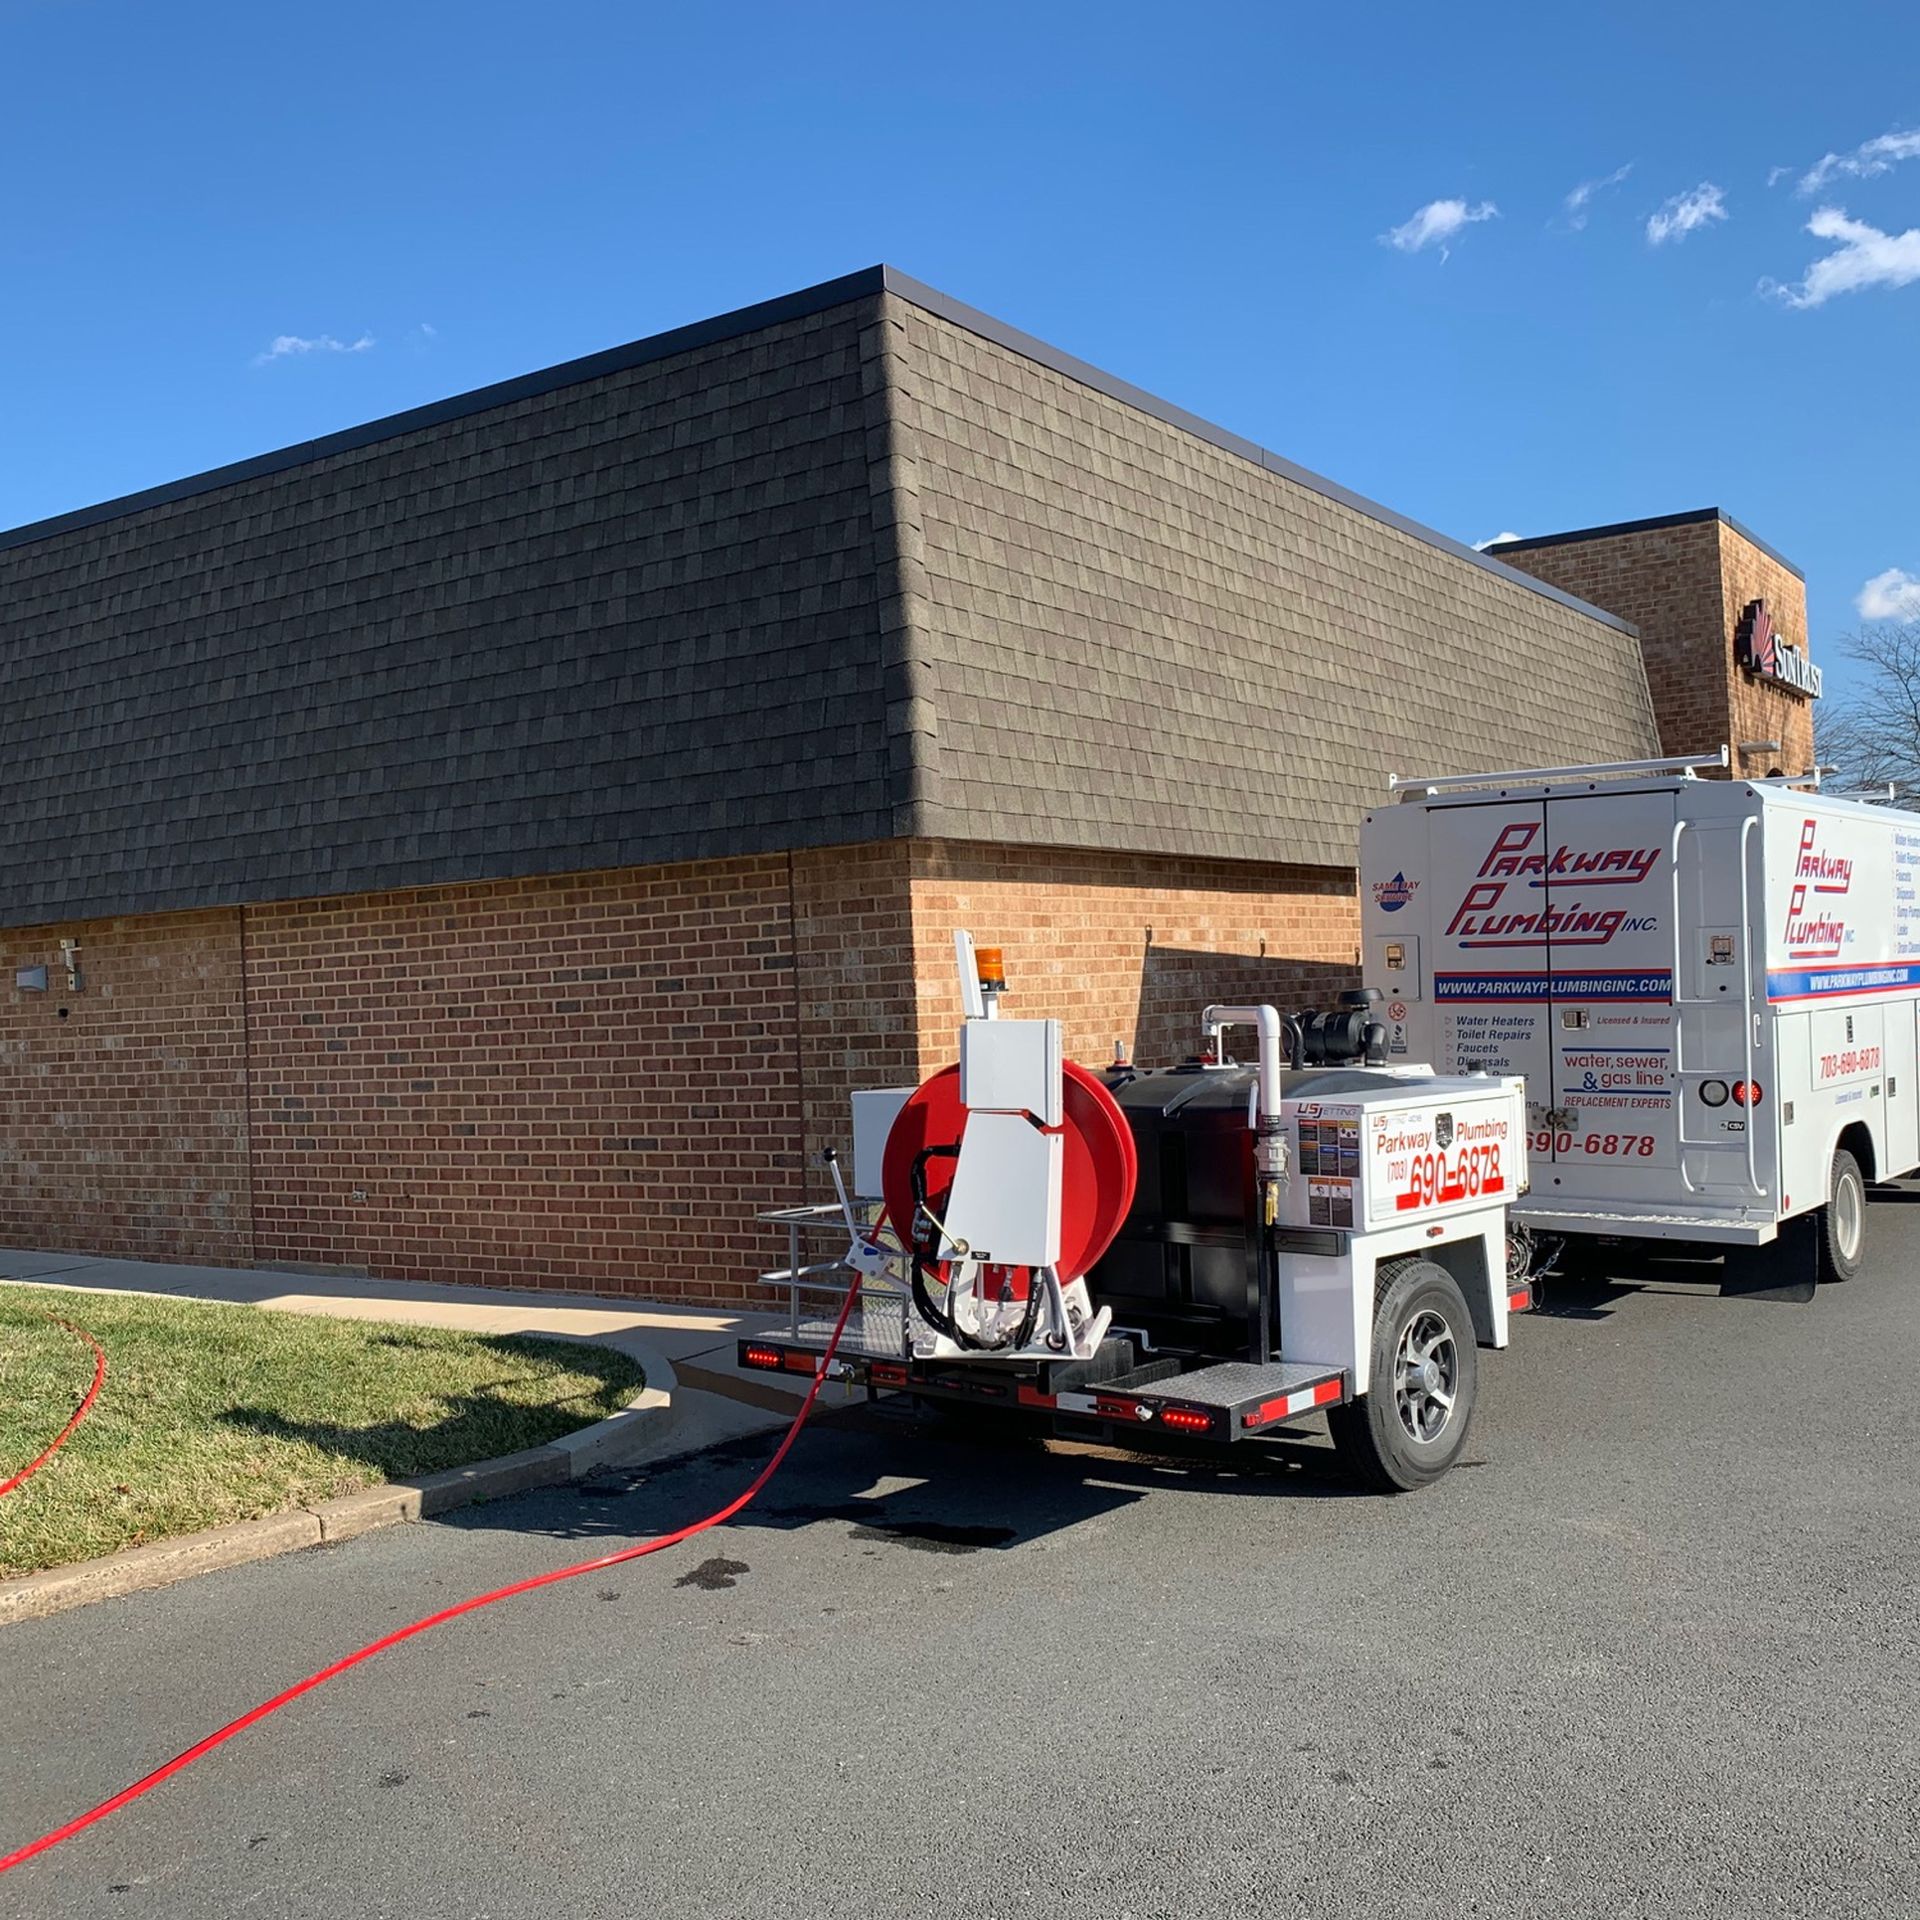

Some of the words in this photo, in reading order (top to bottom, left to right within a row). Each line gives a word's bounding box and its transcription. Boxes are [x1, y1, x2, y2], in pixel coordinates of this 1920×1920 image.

[1620, 917, 1658, 932] INC.
[1437, 979, 1672, 995] WWW.PARKWAYPLUMBINGINC.COM
[1456, 1015, 1488, 1026] Water
[1491, 1016, 1536, 1027] Heaters
[1597, 1016, 1632, 1025] Licensed
[1640, 1016, 1671, 1025] Insured
[1456, 1029, 1487, 1040] Toilet
[1488, 1029, 1533, 1042] Repairs
[1456, 1042, 1500, 1054] Faucets
[1564, 1054, 1614, 1070] water,
[1616, 1057, 1669, 1070] sewer,
[1819, 1046, 1880, 1080] 703-690-6878
[1582, 1071, 1599, 1090] &
[1601, 1072, 1632, 1088] gas
[1636, 1070, 1665, 1085] line
[1563, 1096, 1630, 1108] REPLACEMENT
[1630, 1097, 1672, 1109] EXPERTS
[1376, 1131, 1432, 1155] Parkway
[1456, 1118, 1508, 1142] Plumbing
[1408, 1143, 1502, 1207] 690-6878
